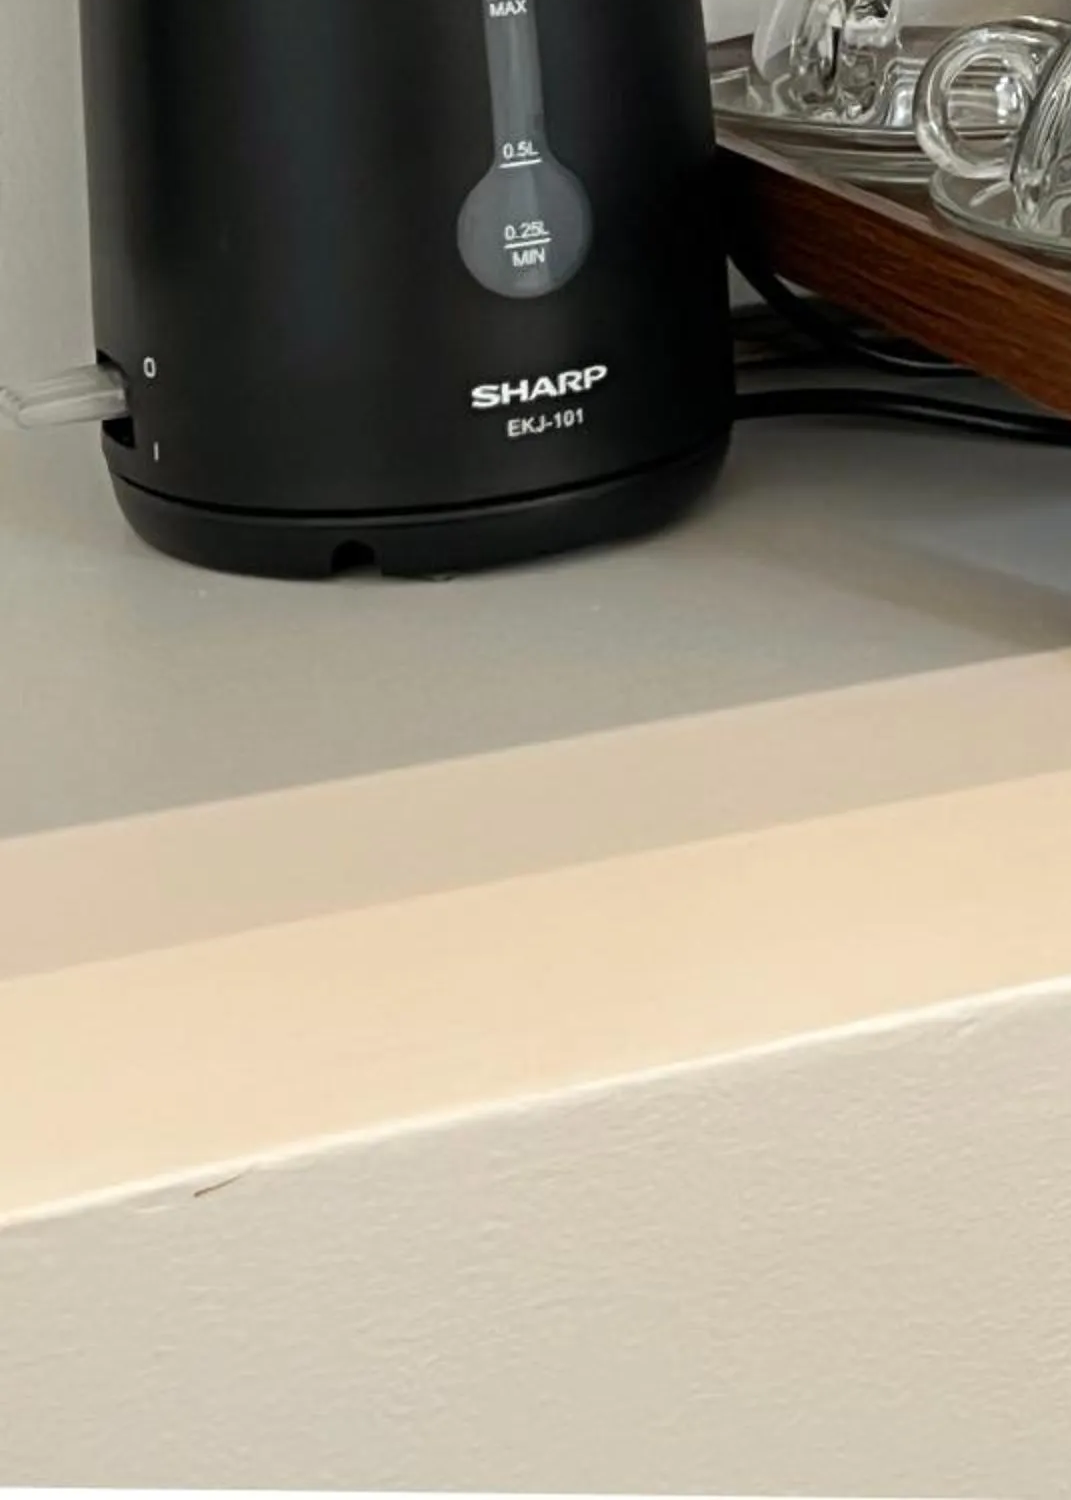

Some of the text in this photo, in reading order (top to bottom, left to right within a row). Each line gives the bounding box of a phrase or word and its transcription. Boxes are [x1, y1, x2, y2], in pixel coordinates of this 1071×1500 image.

[489, 0, 528, 17] MAX
[502, 139, 540, 160] 0.5L
[503, 219, 551, 241] 0.25L
[511, 247, 546, 267] MIN
[471, 364, 608, 409] SHARP
[506, 407, 585, 438] EKJ-101
